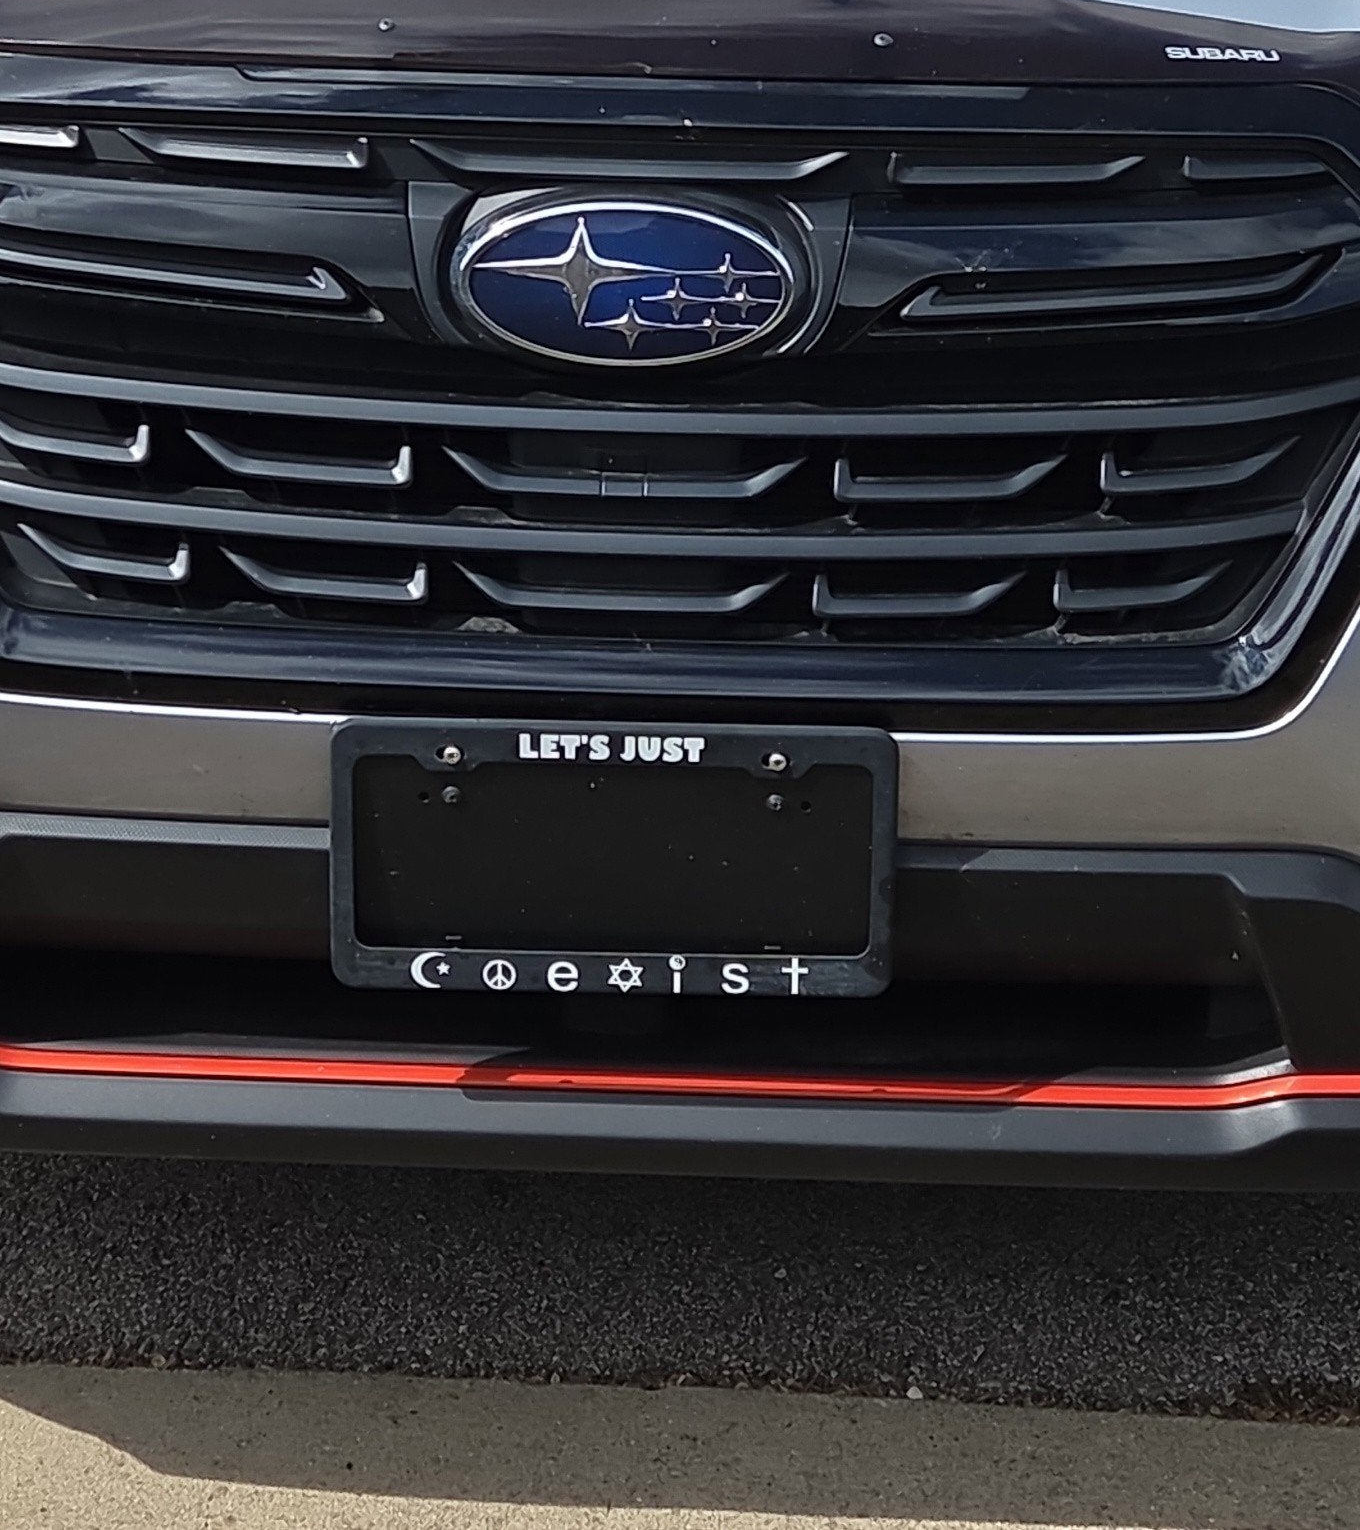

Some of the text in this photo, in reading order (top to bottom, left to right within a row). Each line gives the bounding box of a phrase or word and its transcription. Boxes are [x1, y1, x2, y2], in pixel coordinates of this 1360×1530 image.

[1164, 46, 1281, 62] SUBARU
[518, 732, 705, 763] LET'S JUST
